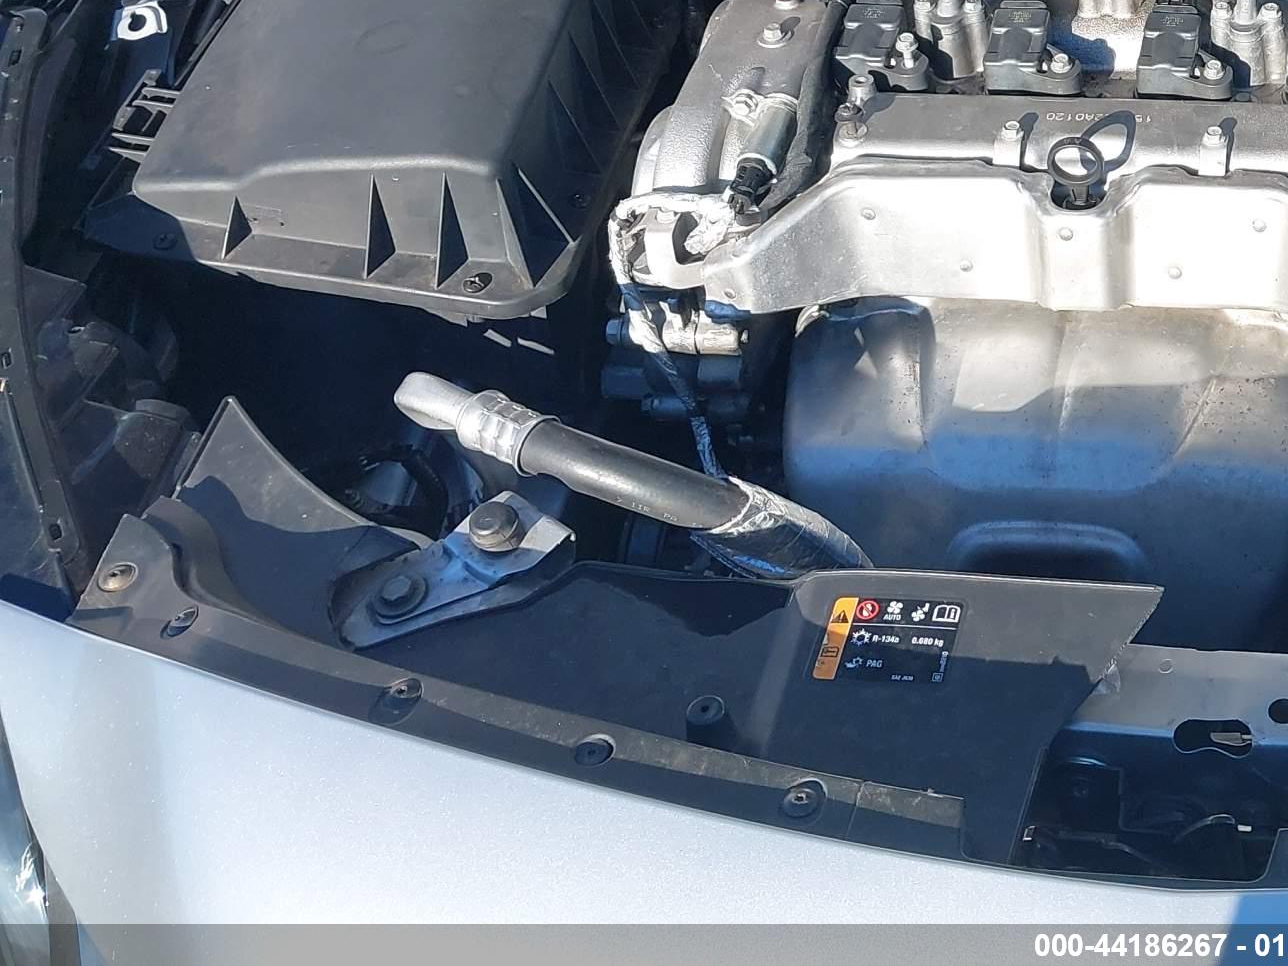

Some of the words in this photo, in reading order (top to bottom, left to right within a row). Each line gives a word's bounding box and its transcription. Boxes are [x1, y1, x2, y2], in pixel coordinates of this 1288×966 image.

[872, 634, 900, 643] R-134a
[911, 636, 933, 645] 0.680
[933, 637, 944, 647] kg
[866, 659, 883, 668] PAG
